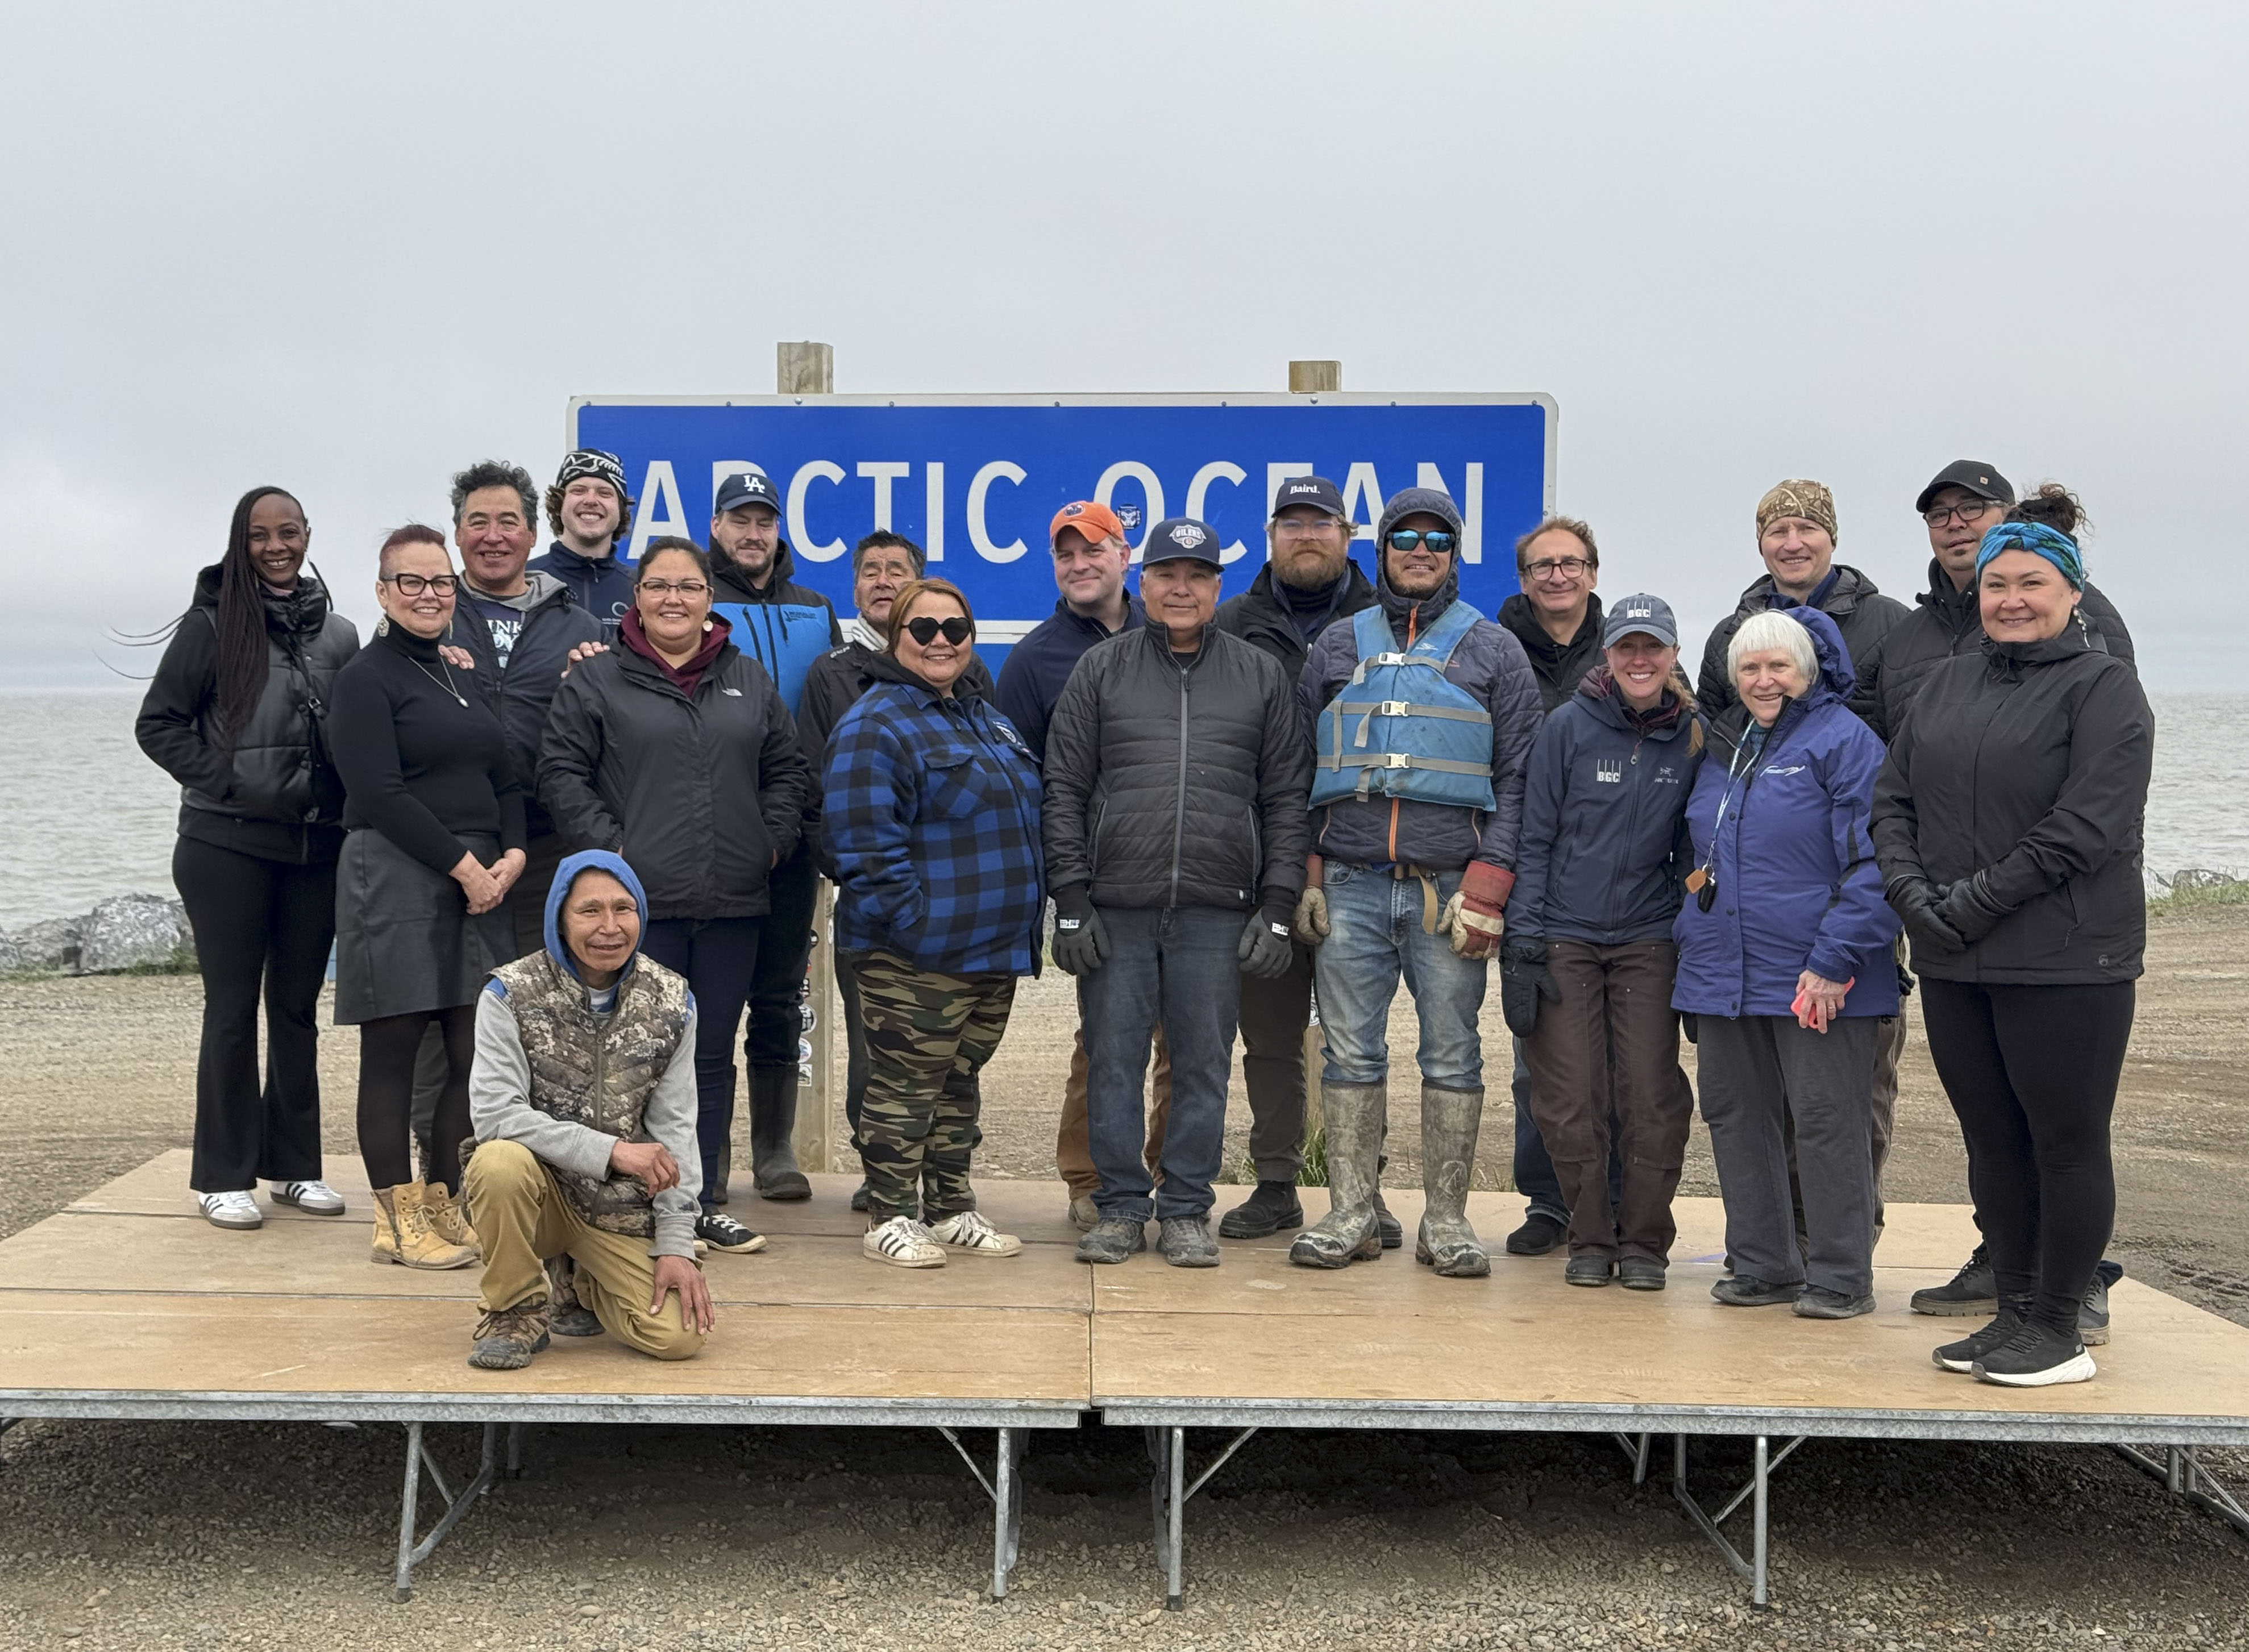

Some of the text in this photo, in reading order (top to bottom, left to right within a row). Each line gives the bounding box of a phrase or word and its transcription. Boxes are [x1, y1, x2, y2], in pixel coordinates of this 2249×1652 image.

[743, 475, 766, 494] LA
[626, 460, 1028, 563] ACTIC
[1176, 528, 1202, 540] OILERS
[1598, 771, 1619, 783] BGC
